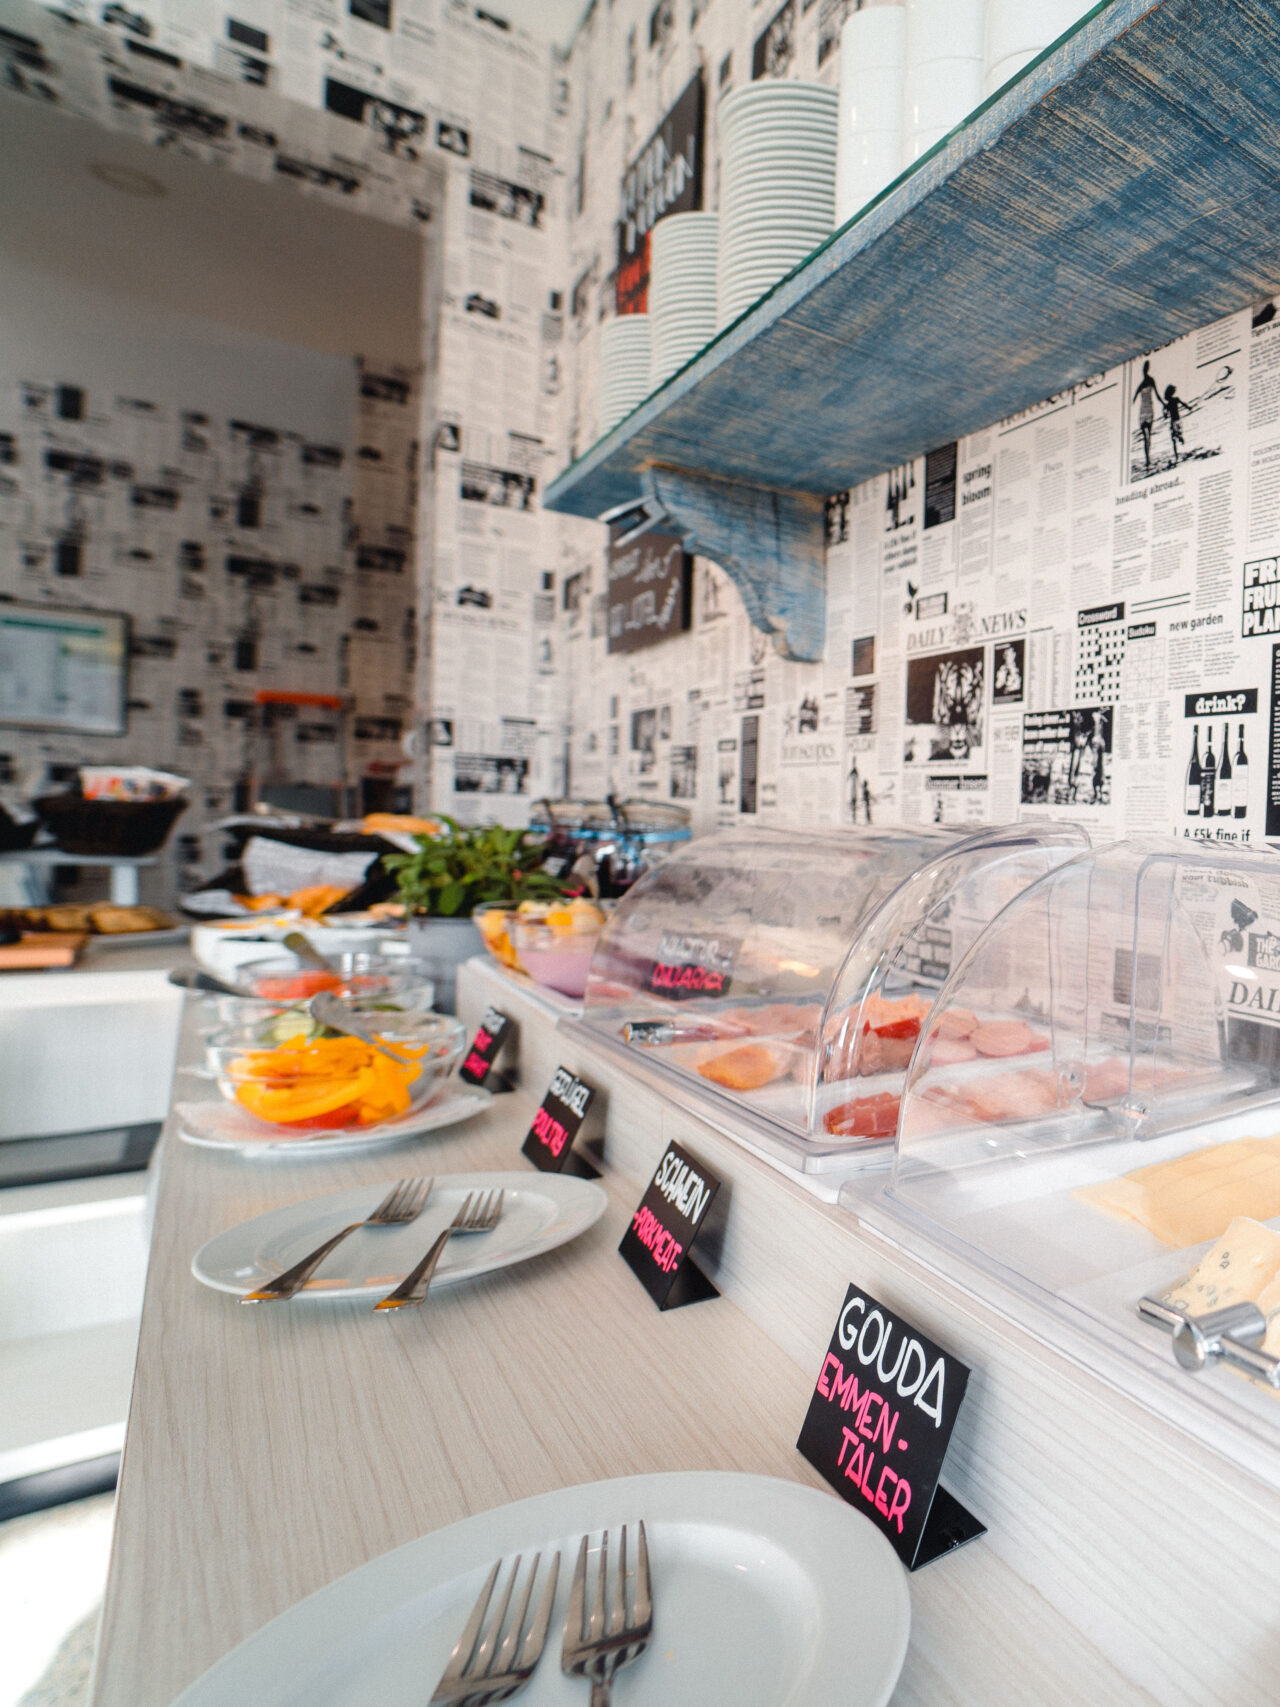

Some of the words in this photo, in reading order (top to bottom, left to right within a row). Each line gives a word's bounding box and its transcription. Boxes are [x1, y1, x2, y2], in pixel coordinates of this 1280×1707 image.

[906, 627, 948, 649] DAILY
[981, 609, 1027, 634] NEWS
[1170, 621, 1188, 632] new
[1190, 614, 1223, 631] garden
[1195, 694, 1246, 714] drink?
[838, 1297, 946, 1427] GOUDA
[817, 1352, 909, 1454] EMMEN-
[837, 1426, 913, 1534] TALER
